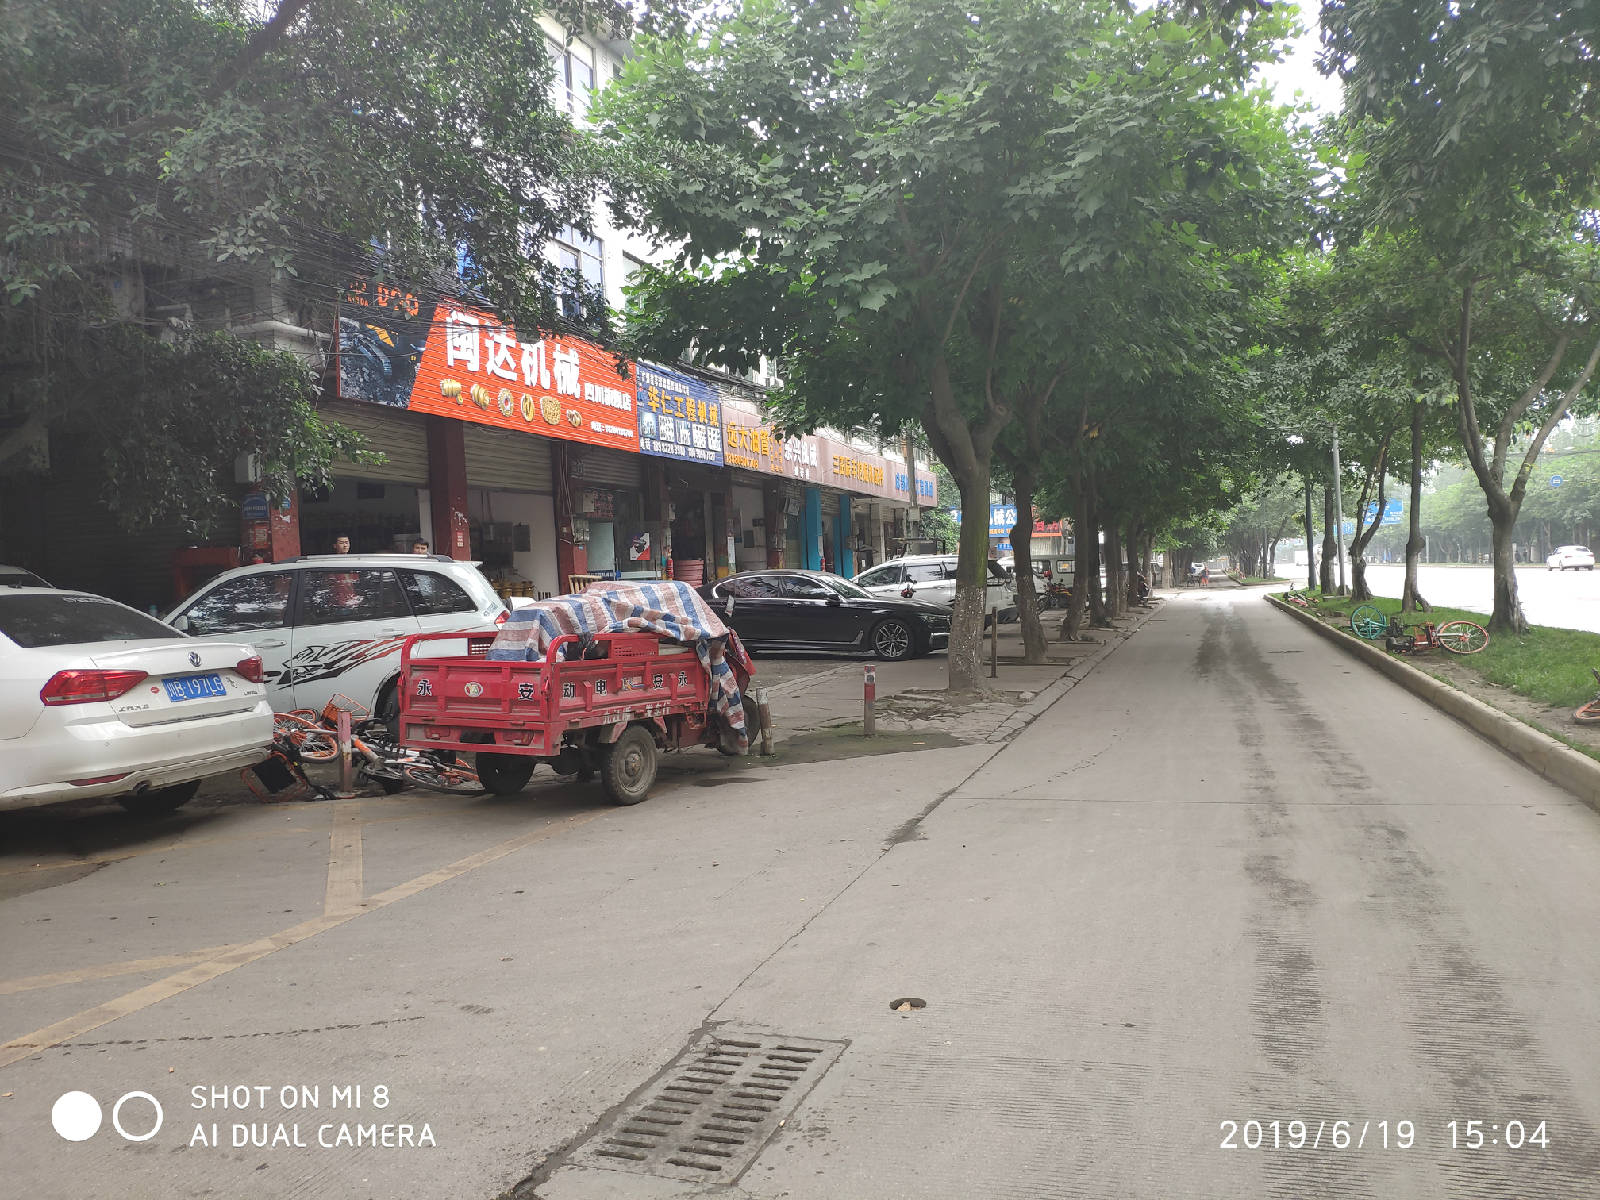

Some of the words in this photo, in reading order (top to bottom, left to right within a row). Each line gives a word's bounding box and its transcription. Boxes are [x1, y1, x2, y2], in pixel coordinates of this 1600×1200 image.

[727, 422, 770, 456] 远大油管
[417, 679, 433, 697] 永
[518, 682, 534, 701] 安
[563, 682, 576, 698] 动
[594, 679, 607, 696] 电
